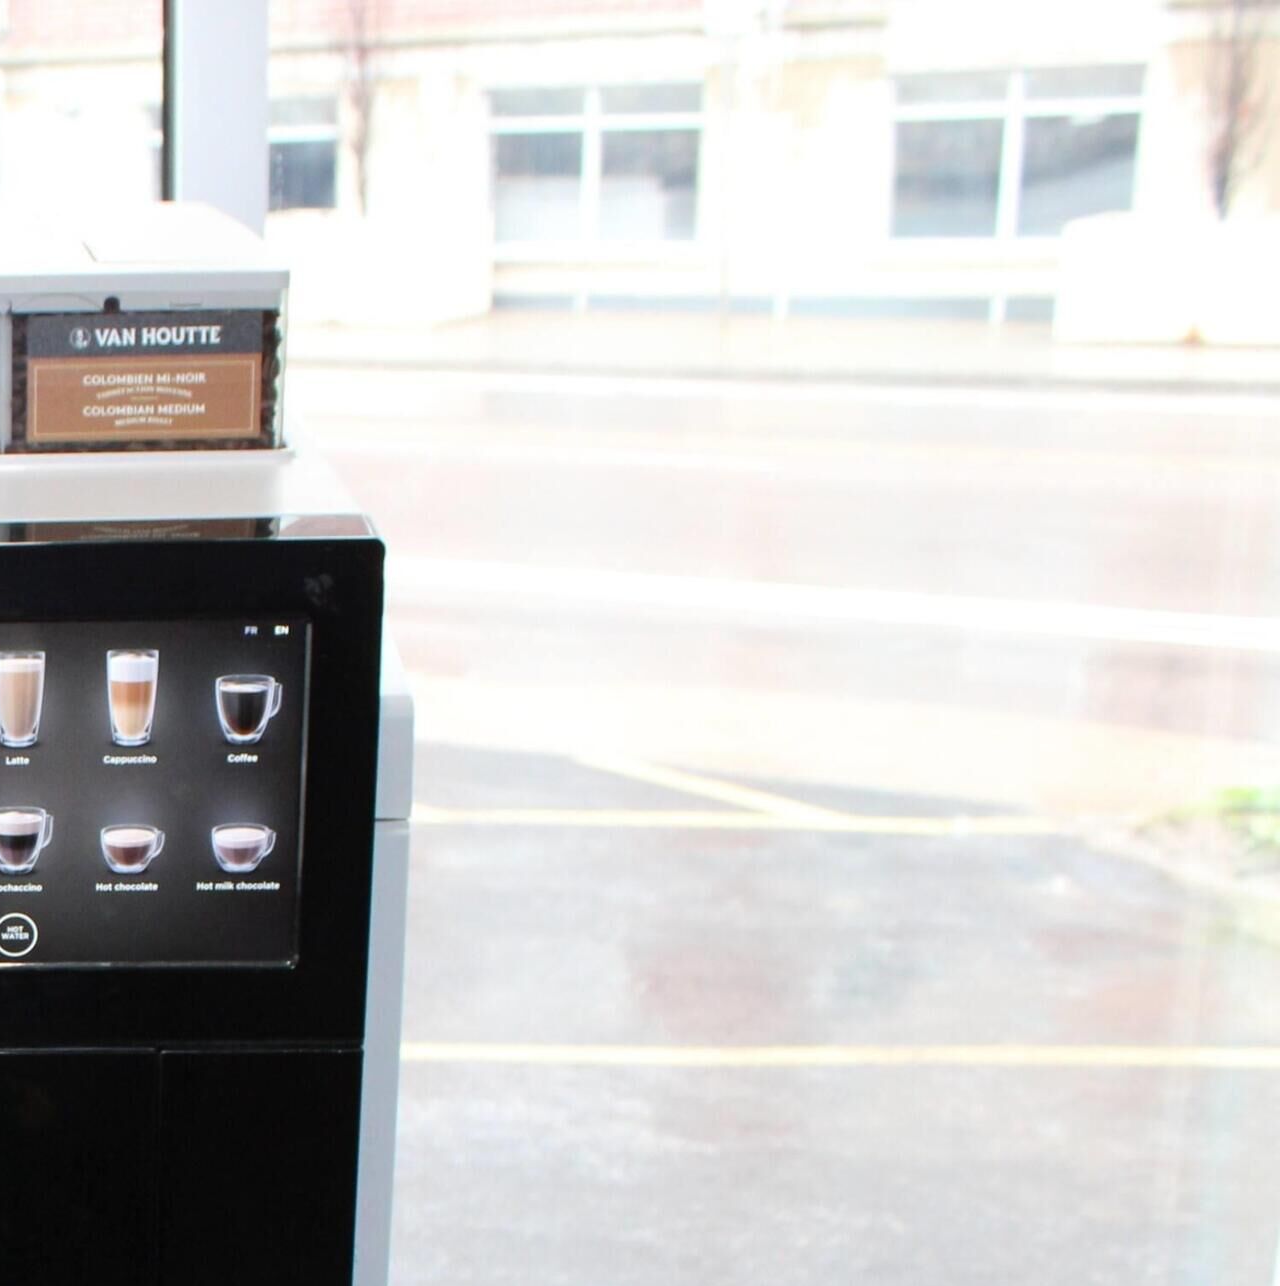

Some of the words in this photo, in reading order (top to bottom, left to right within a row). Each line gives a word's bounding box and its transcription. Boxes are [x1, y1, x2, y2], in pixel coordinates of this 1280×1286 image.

[95, 328, 136, 347] VAN
[141, 325, 222, 345] HOUTTE
[82, 374, 153, 386] COLOMBIEN
[156, 372, 206, 383] MI-NOIR
[82, 405, 154, 417] COLOMBIAN
[158, 404, 205, 414] MEDIUM
[244, 626, 258, 635] FR
[274, 625, 289, 635] EN
[6, 757, 29, 765] Latte
[103, 755, 157, 764] Cappuccino
[227, 754, 258, 763] Coffee
[96, 883, 112, 891] Hot
[114, 883, 158, 891] chocolate
[196, 882, 213, 890] Hot
[215, 882, 233, 890] milk
[236, 881, 280, 890] chocolate
